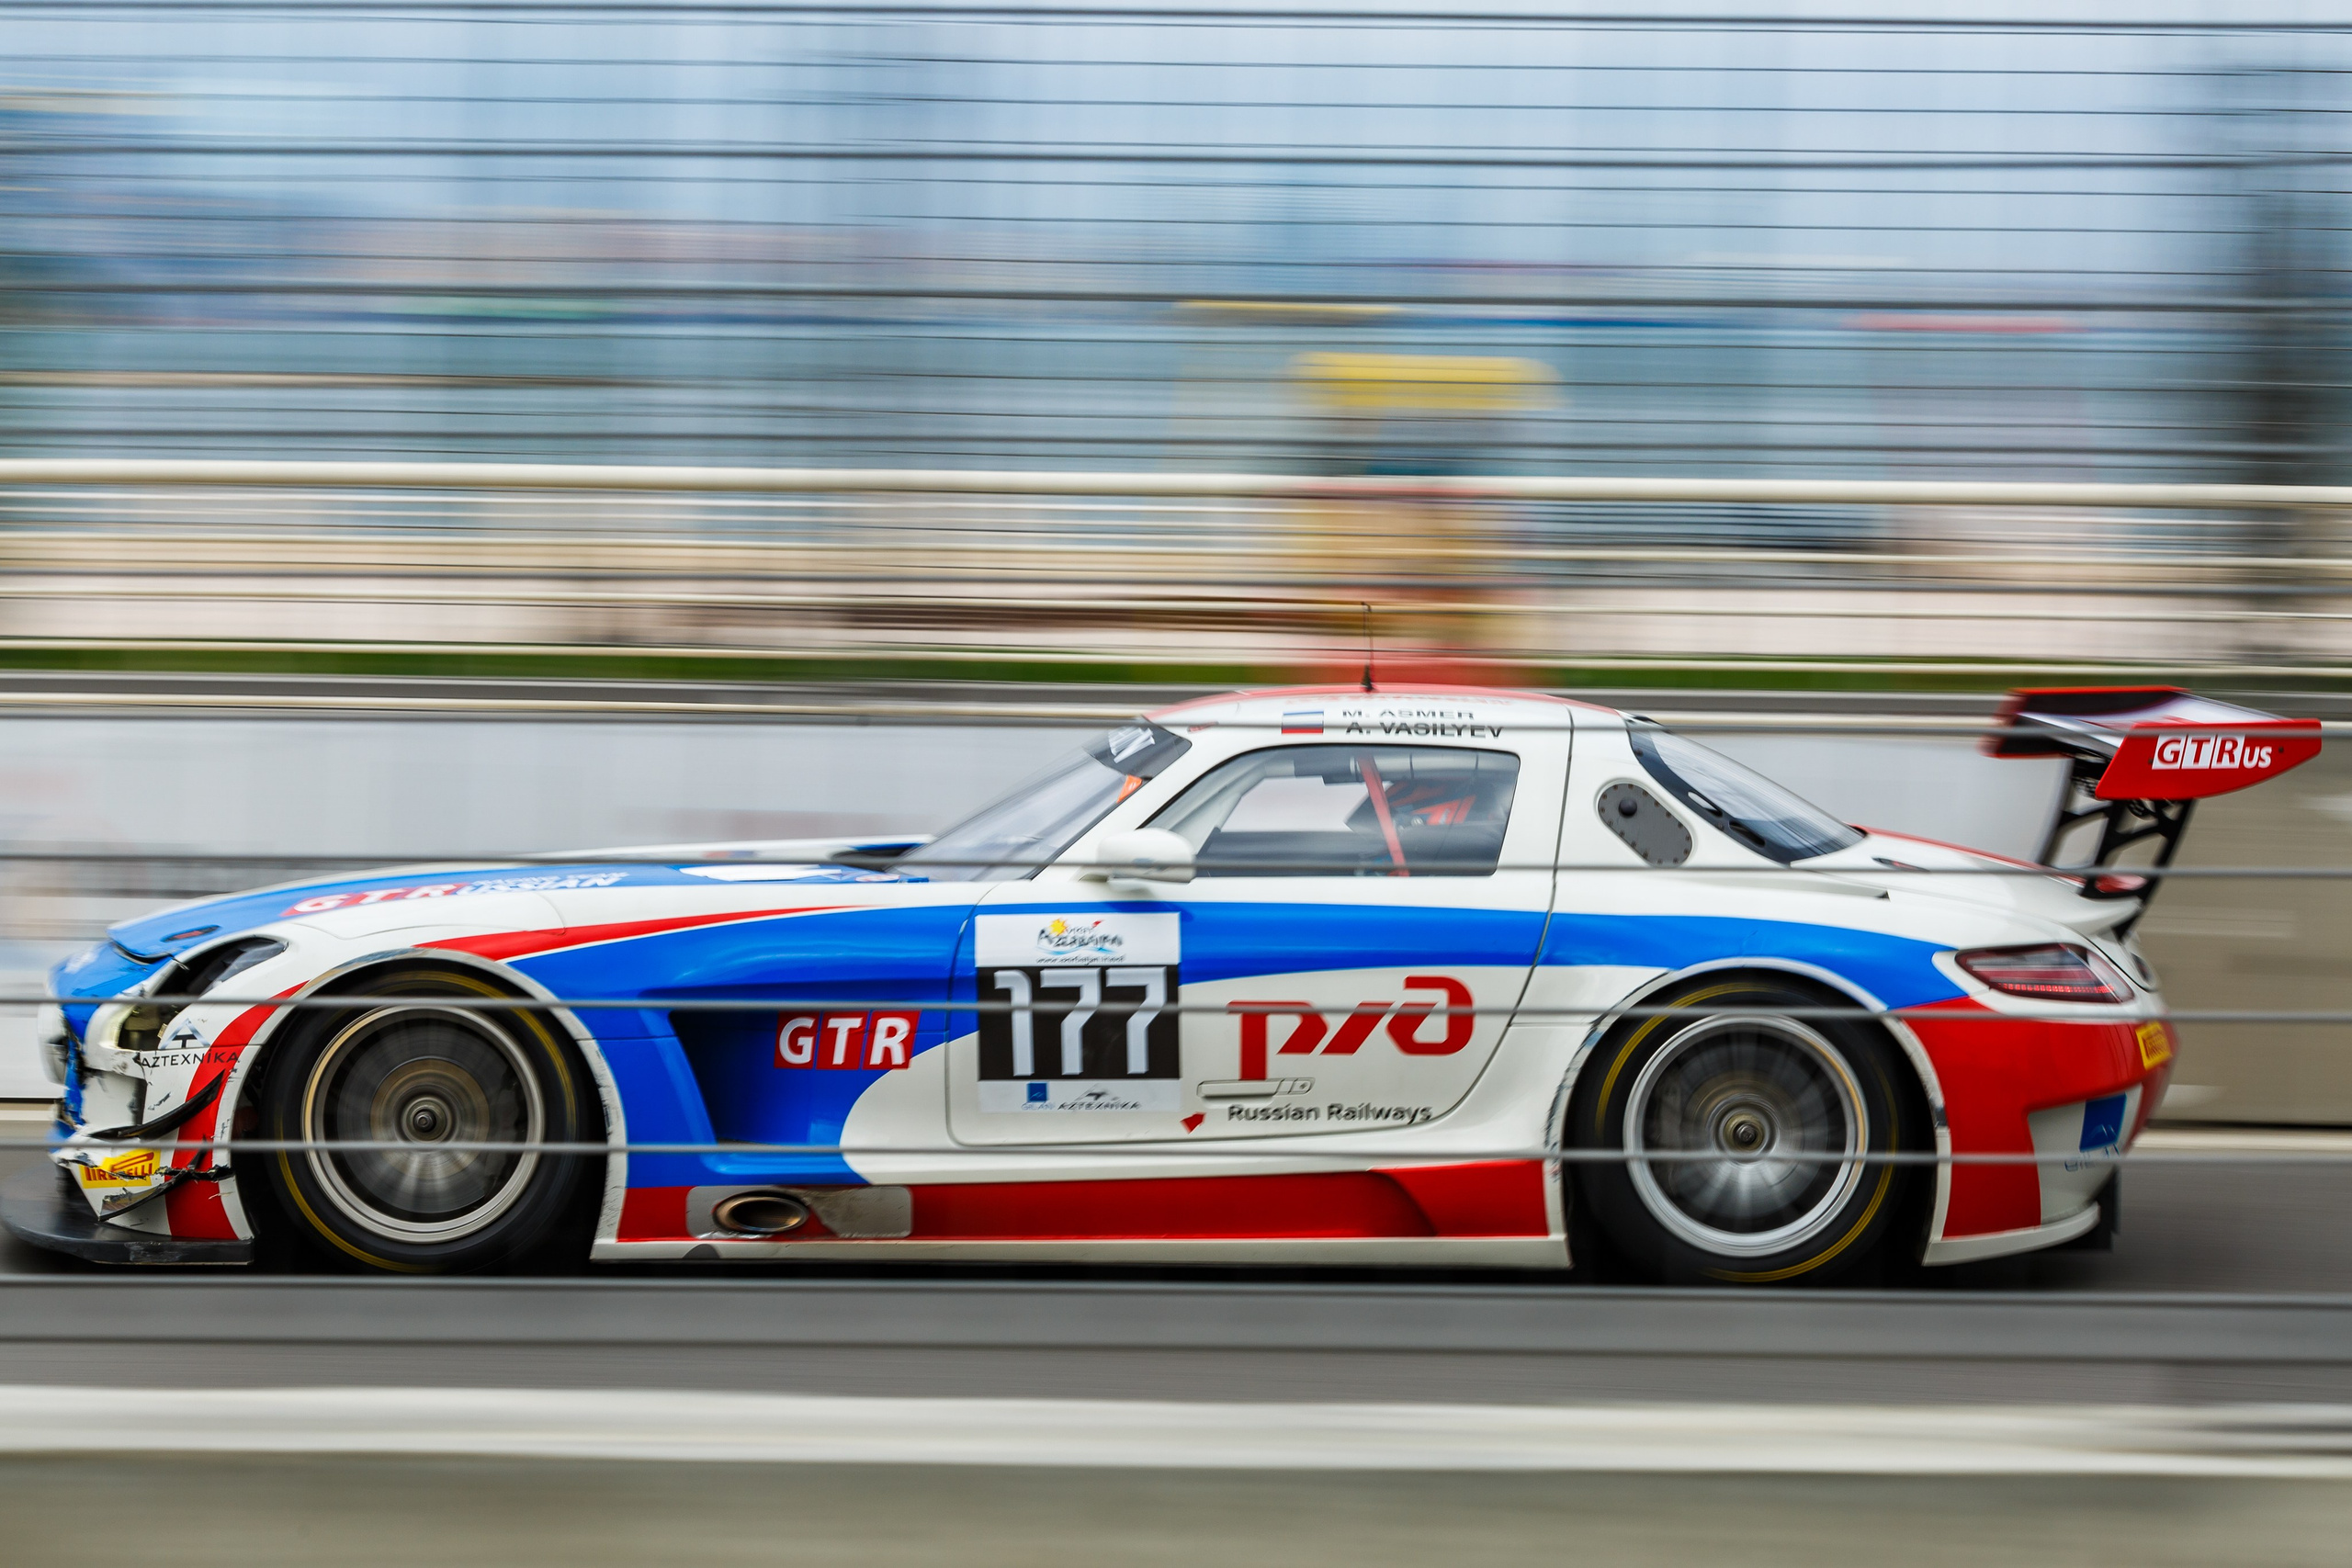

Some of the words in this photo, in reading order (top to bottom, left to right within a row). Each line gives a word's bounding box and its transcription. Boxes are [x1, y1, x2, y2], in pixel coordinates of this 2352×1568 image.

[1379, 708, 1475, 720] ASMER
[1345, 721, 1371, 735] A.
[1379, 722, 1504, 739] VASILYEV
[993, 966, 1168, 1077] 177
[778, 1016, 911, 1066] GTR
[1227, 1103, 1321, 1122] Russian
[1327, 1102, 1433, 1125] Railways
